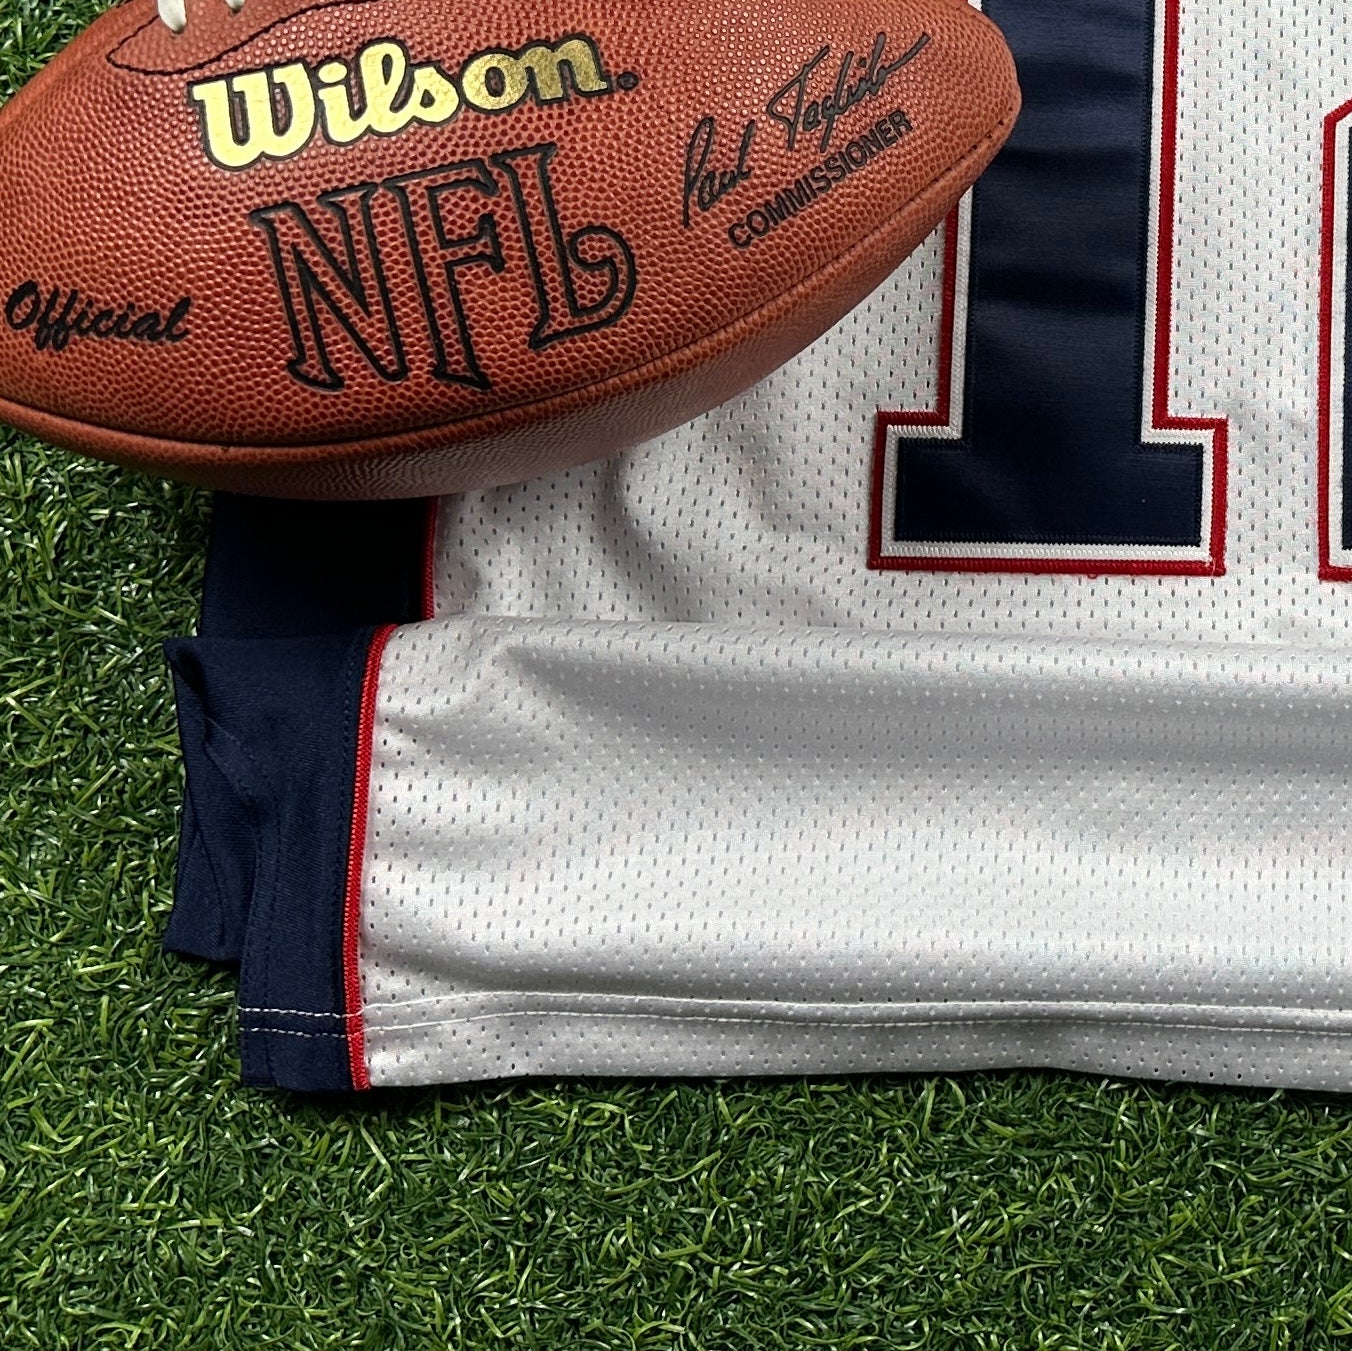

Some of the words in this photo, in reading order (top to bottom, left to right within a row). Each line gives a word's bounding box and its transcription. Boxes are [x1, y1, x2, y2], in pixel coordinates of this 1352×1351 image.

[187, 33, 613, 173] Wilson
[728, 108, 914, 248] COMMISSIONER
[5, 279, 192, 352] Official
[248, 143, 638, 392] NFL
